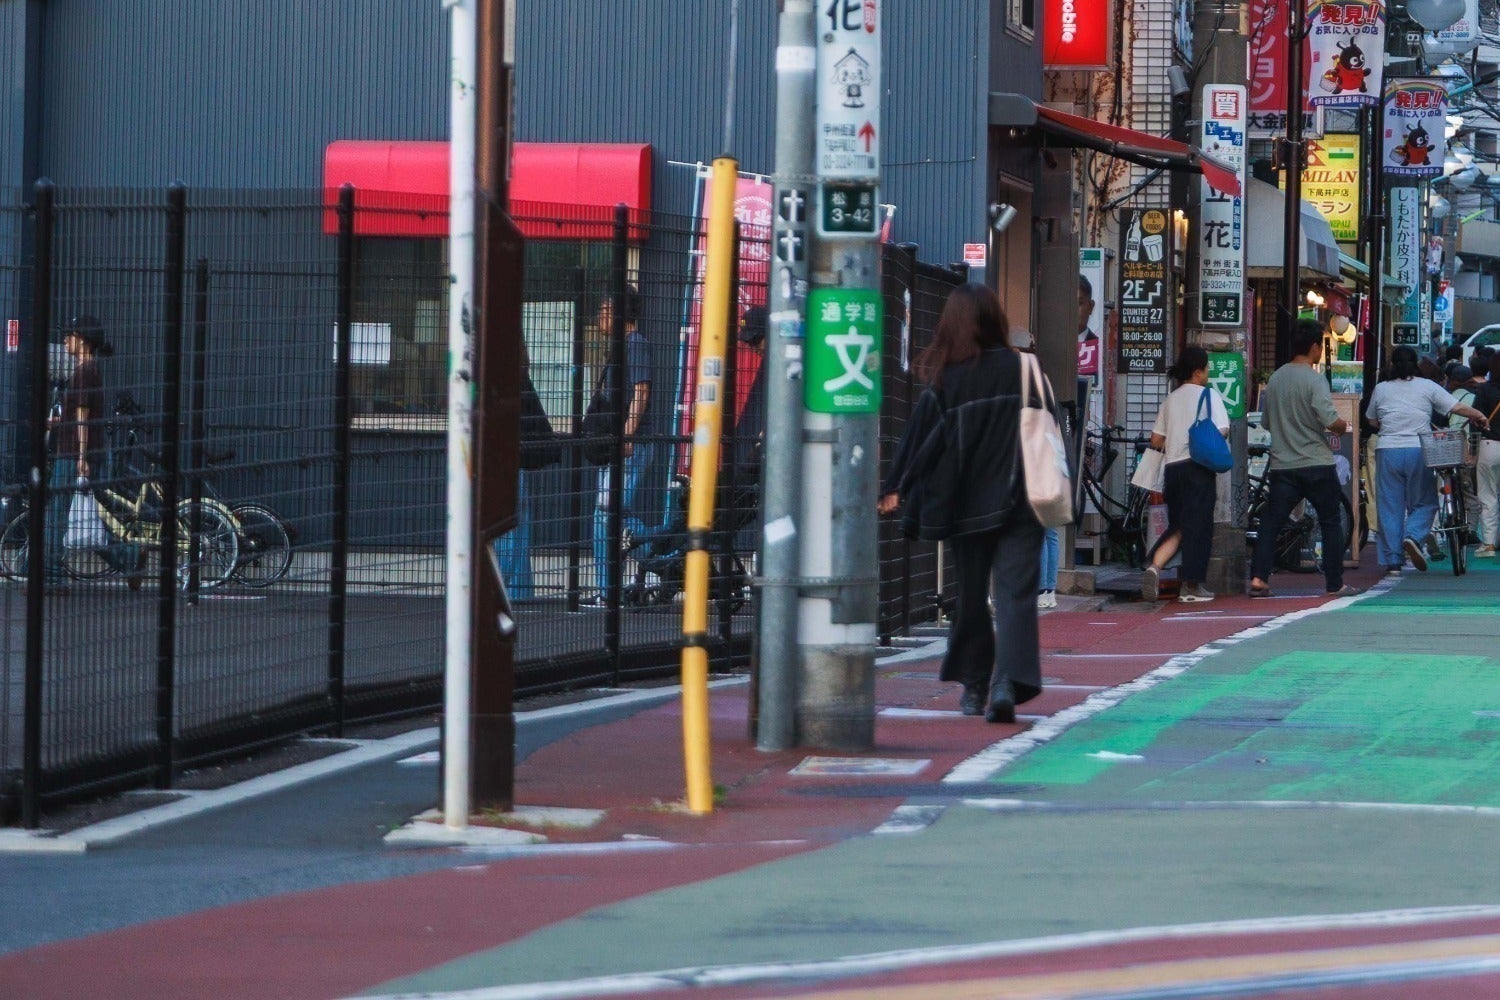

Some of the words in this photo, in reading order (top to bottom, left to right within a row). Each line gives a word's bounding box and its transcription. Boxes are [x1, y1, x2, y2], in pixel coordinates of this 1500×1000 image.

[1315, 25, 1379, 36] お気に入りの店
[1388, 108, 1442, 118] お気に入りの店
[1301, 170, 1358, 183] MILAN
[1307, 188, 1349, 197] 下高井戸店
[831, 208, 871, 222] 3-42
[1396, 189, 1410, 284] しもたか皮フ科
[1203, 258, 1241, 269] 甲州街道
[1122, 279, 1145, 299] 2F
[1122, 307, 1149, 316] COUNTER
[1150, 308, 1163, 320] 27
[1207, 310, 1236, 320] 3-42
[1122, 332, 1163, 341] 18:00-26:00
[1122, 348, 1162, 358] 17:00-25:00
[1129, 359, 1155, 368] AGLIO
